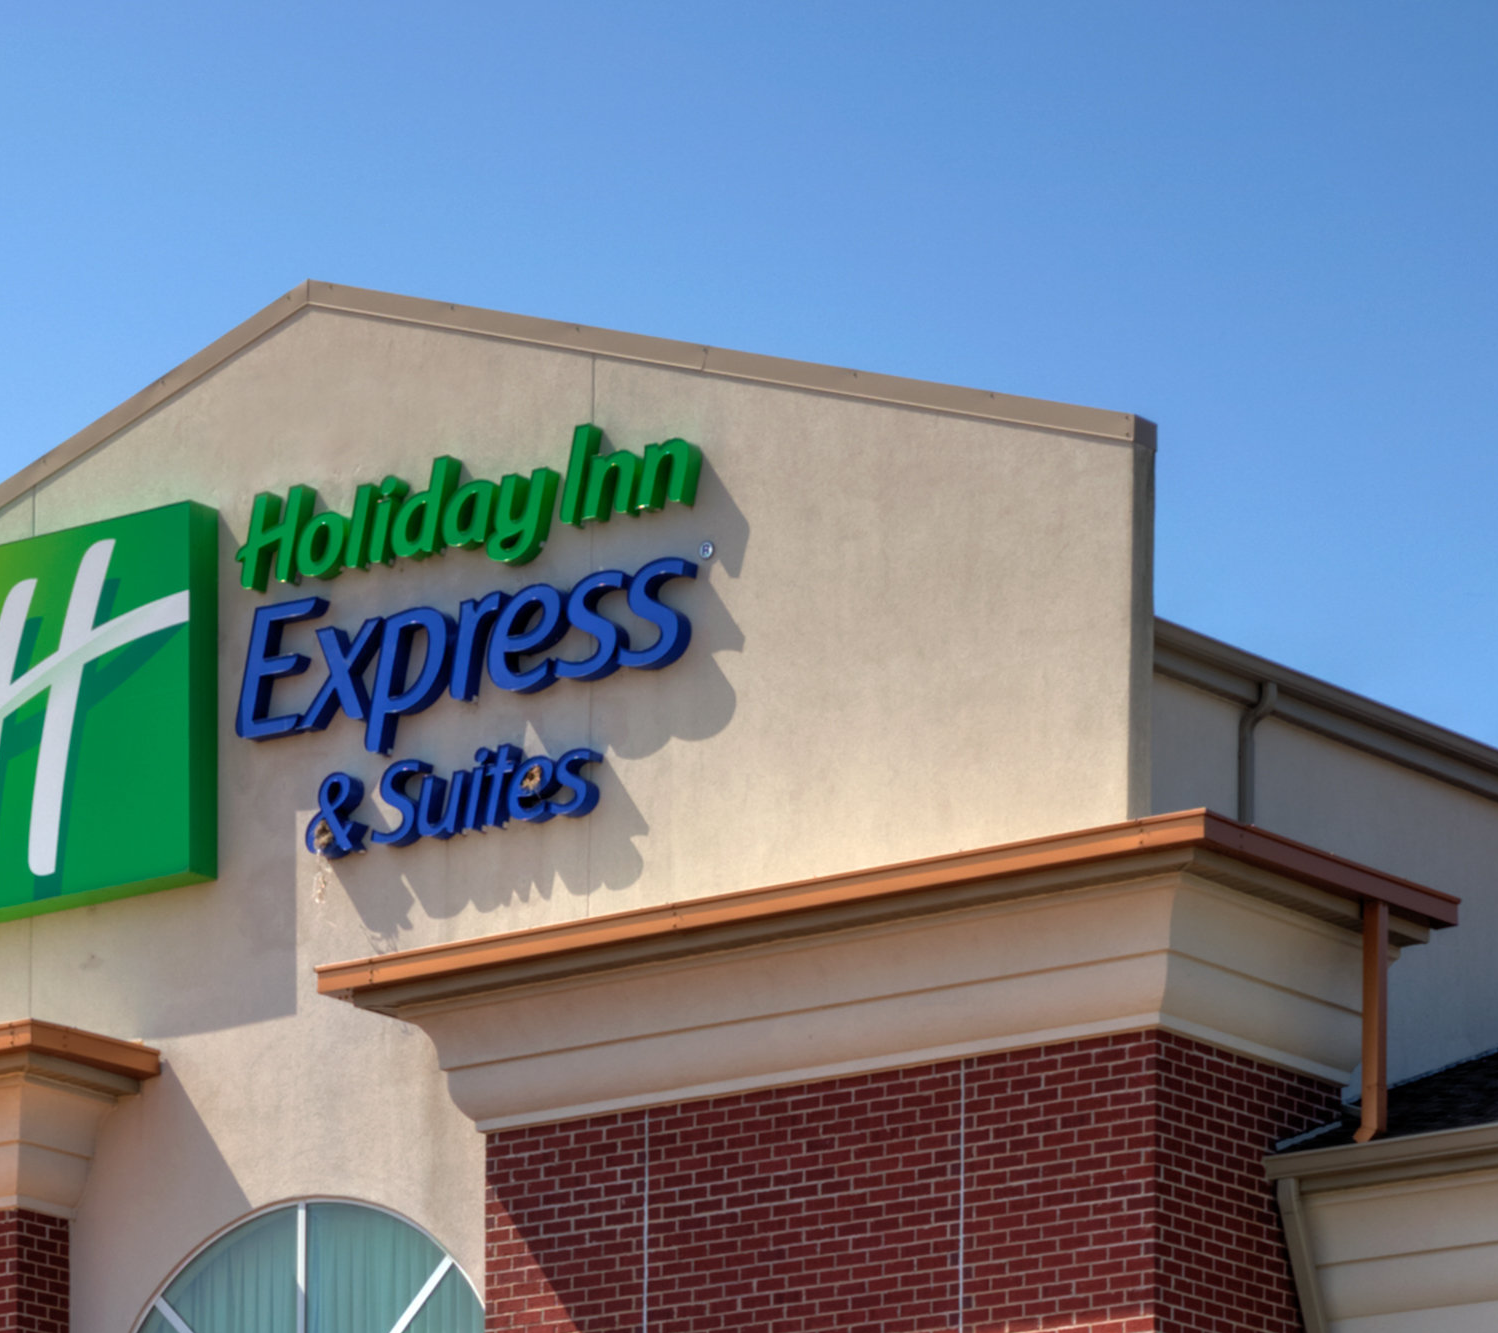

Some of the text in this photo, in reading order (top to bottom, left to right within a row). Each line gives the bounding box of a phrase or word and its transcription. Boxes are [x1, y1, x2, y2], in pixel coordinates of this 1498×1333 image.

[236, 424, 702, 592] Holiday Inn
[235, 556, 698, 754] Express
[305, 743, 603, 860] & Suites
